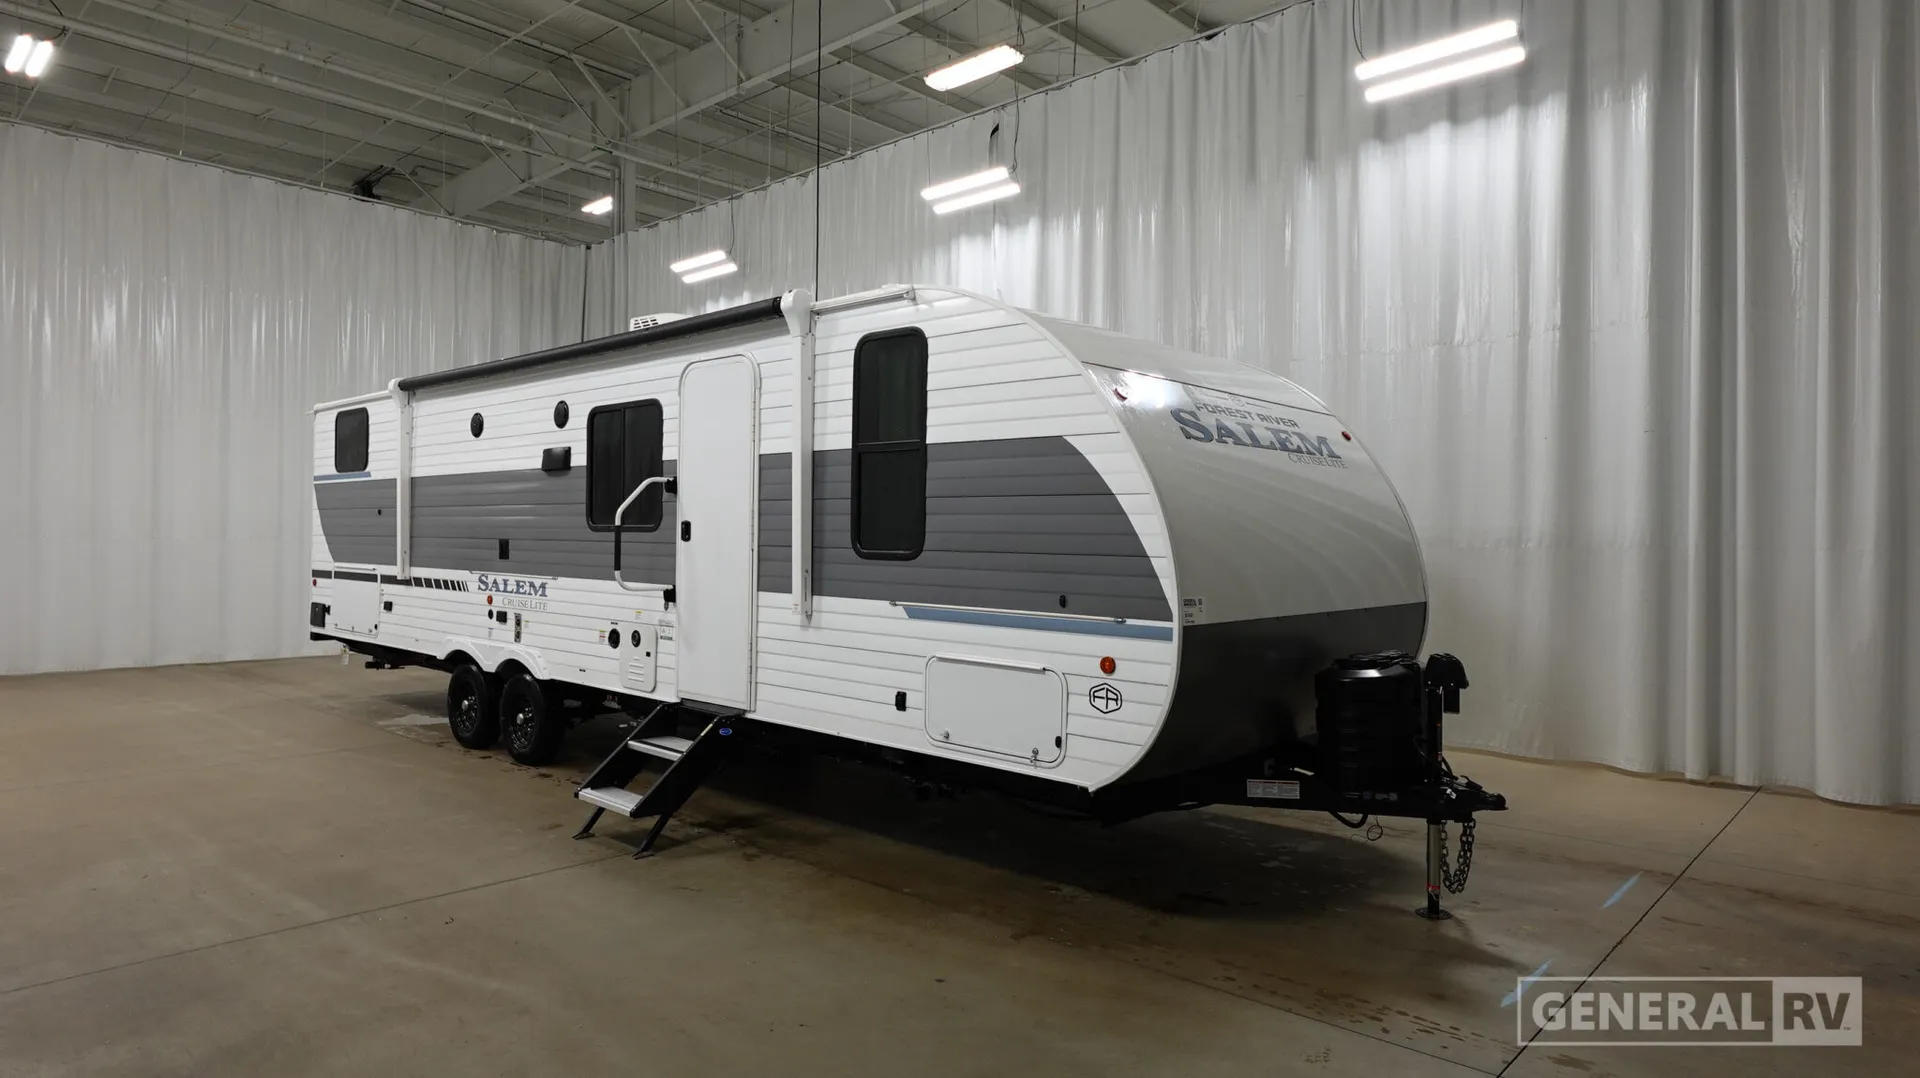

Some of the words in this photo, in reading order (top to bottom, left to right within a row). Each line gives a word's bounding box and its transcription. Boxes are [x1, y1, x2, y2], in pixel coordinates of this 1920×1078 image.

[1194, 401, 1253, 421] FOREST
[1259, 412, 1300, 428] RIVER
[1170, 407, 1342, 459] SALEM
[477, 573, 548, 597] SALEM
